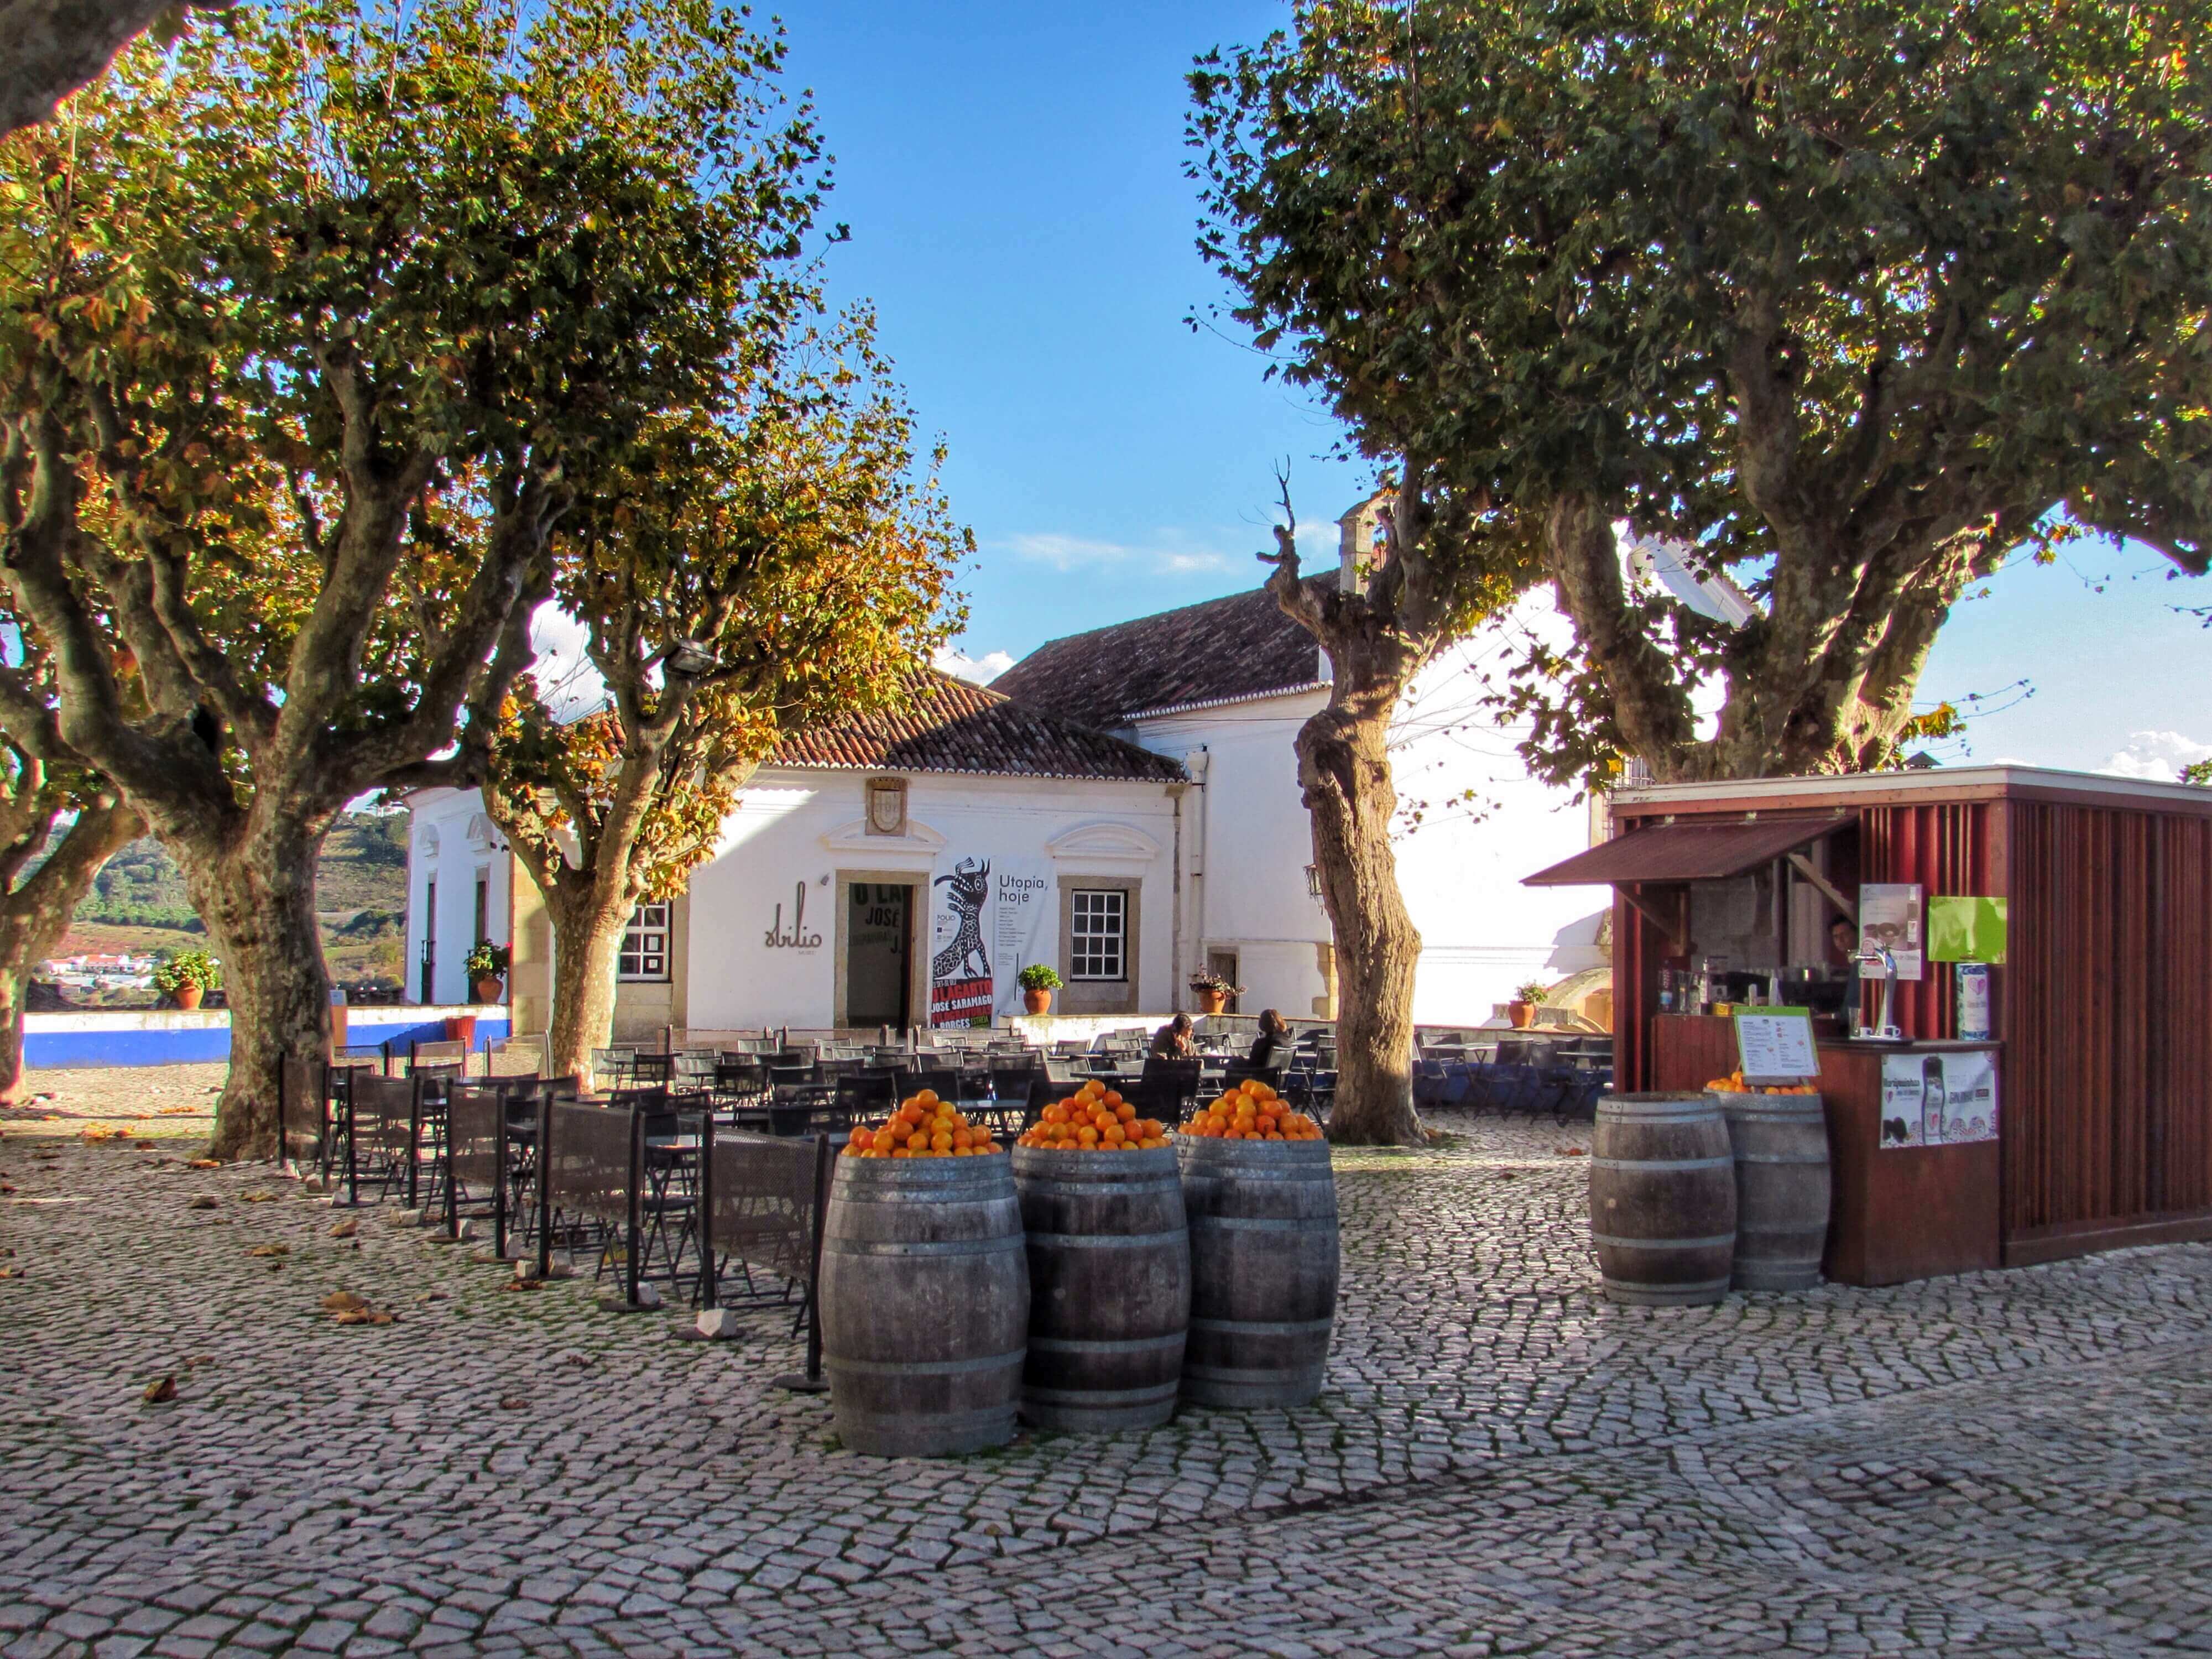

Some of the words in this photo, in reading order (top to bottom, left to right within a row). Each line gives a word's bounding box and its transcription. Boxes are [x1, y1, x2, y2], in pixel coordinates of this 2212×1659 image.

[1000, 875, 1048, 891] Utopia,
[999, 888, 1029, 905] hoje
[865, 907, 900, 928] JOSÉ
[940, 979, 992, 1001] LAGARTO
[931, 1000, 950, 1013] JOSÉ
[951, 994, 992, 1010] SARAMAGO
[940, 1018, 971, 1029] BORGES
